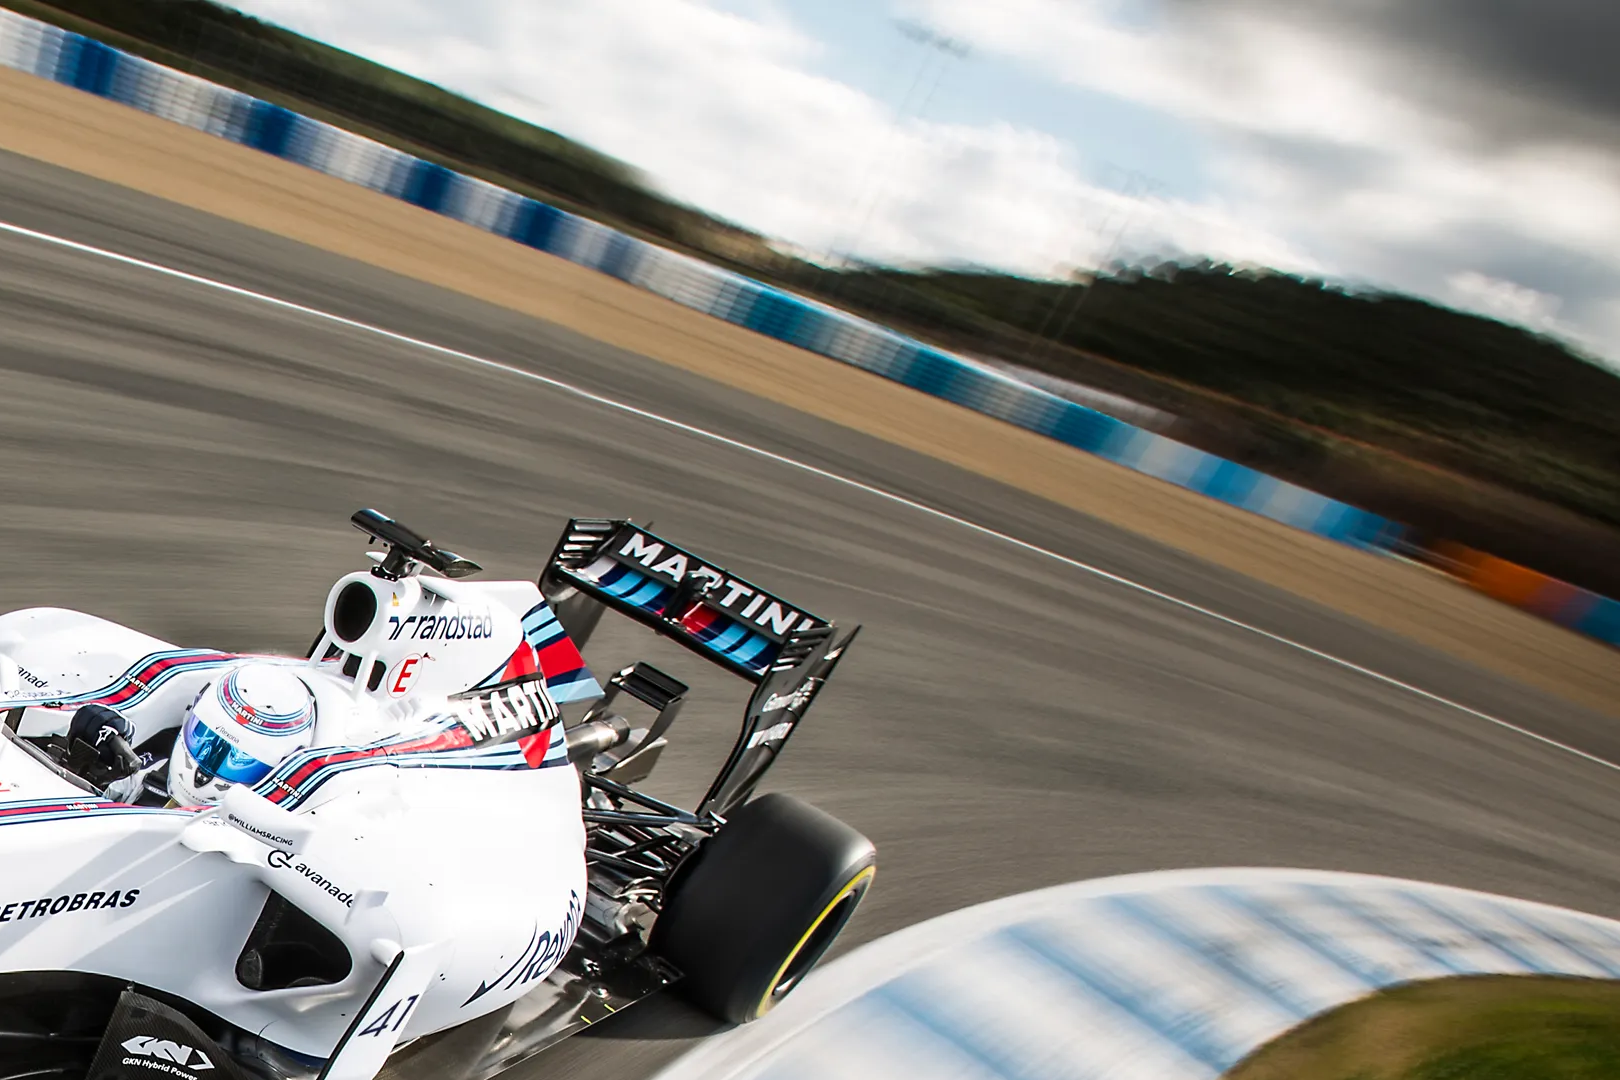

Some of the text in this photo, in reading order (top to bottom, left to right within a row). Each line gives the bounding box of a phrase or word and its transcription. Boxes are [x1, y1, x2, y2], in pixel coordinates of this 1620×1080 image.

[411, 605, 494, 640] randstad
[392, 658, 419, 693] E
[231, 701, 264, 727] MARTINI
[272, 777, 303, 801] MARTINI
[227, 812, 294, 847] @WILLIAMSRACING
[357, 993, 421, 1038] 41
[122, 1057, 142, 1066] GKN
[141, 1058, 171, 1073] Hybrid
